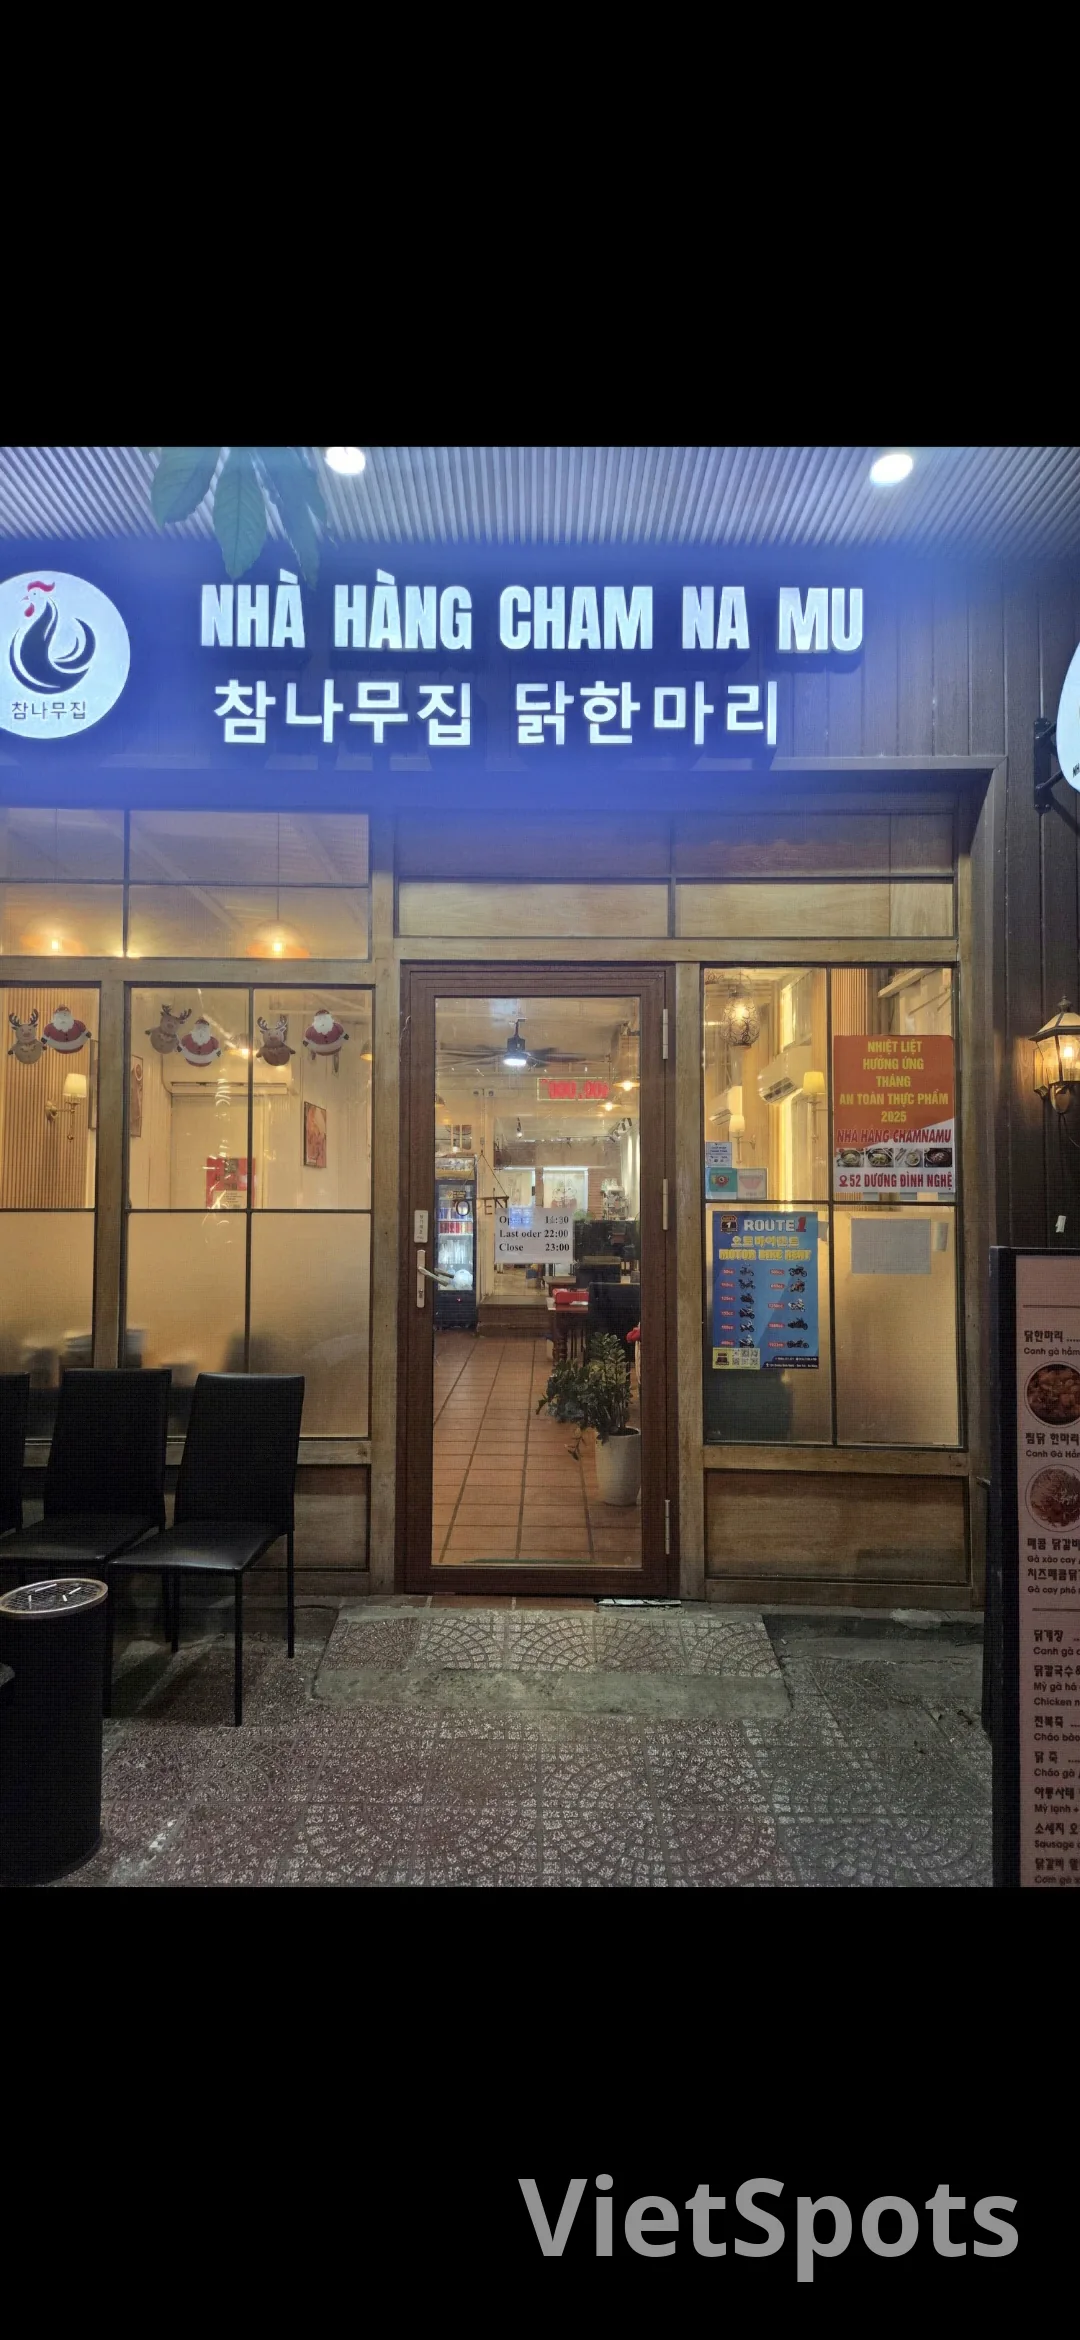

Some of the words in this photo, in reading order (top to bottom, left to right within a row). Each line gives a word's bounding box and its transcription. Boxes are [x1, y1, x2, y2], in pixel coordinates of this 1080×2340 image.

[201, 568, 305, 648] NHÀ
[334, 569, 472, 649] HÀNG
[500, 585, 653, 650] CHAM
[682, 586, 750, 650] NA
[778, 587, 863, 652] MU
[11, 701, 87, 720] 참나무집
[214, 679, 471, 746] 참나무집
[516, 681, 776, 745] 닭한마리
[867, 1039, 898, 1055] NHIỆT
[901, 1039, 922, 1055] LIỆT
[902, 1056, 924, 1070] ỨNG
[876, 1073, 911, 1087] THÁNG
[840, 1093, 854, 1105] AN
[857, 1091, 884, 1105] TOÀN
[887, 1092, 914, 1107] THỰC
[881, 1110, 907, 1122] 2025
[893, 1129, 952, 1143] CHAMNAMU
[849, 1174, 861, 1187] 52
[864, 1172, 897, 1187] DƯƠNG
[900, 1171, 924, 1187] ĐÌNH
[927, 1171, 953, 1190] NGHỆ
[499, 1230, 518, 1238] Last
[521, 1230, 541, 1238] oder
[544, 1229, 568, 1238] 22:00
[499, 1243, 524, 1251] Close
[545, 1243, 570, 1251] 23:00
[1024, 1330, 1063, 1343] 닭한마리
[1024, 1347, 1046, 1355] Canh
[1048, 1348, 1059, 1357] gà
[1026, 1450, 1048, 1458] Canh
[1060, 1557, 1076, 1565] cay
[1027, 1568, 1080, 1581] 치즈매콤닭
[1042, 1587, 1058, 1595] cay
[1033, 1646, 1058, 1655] Canh
[1034, 1697, 1071, 1706] Chicken
[1034, 1840, 1075, 1851] Sausage
